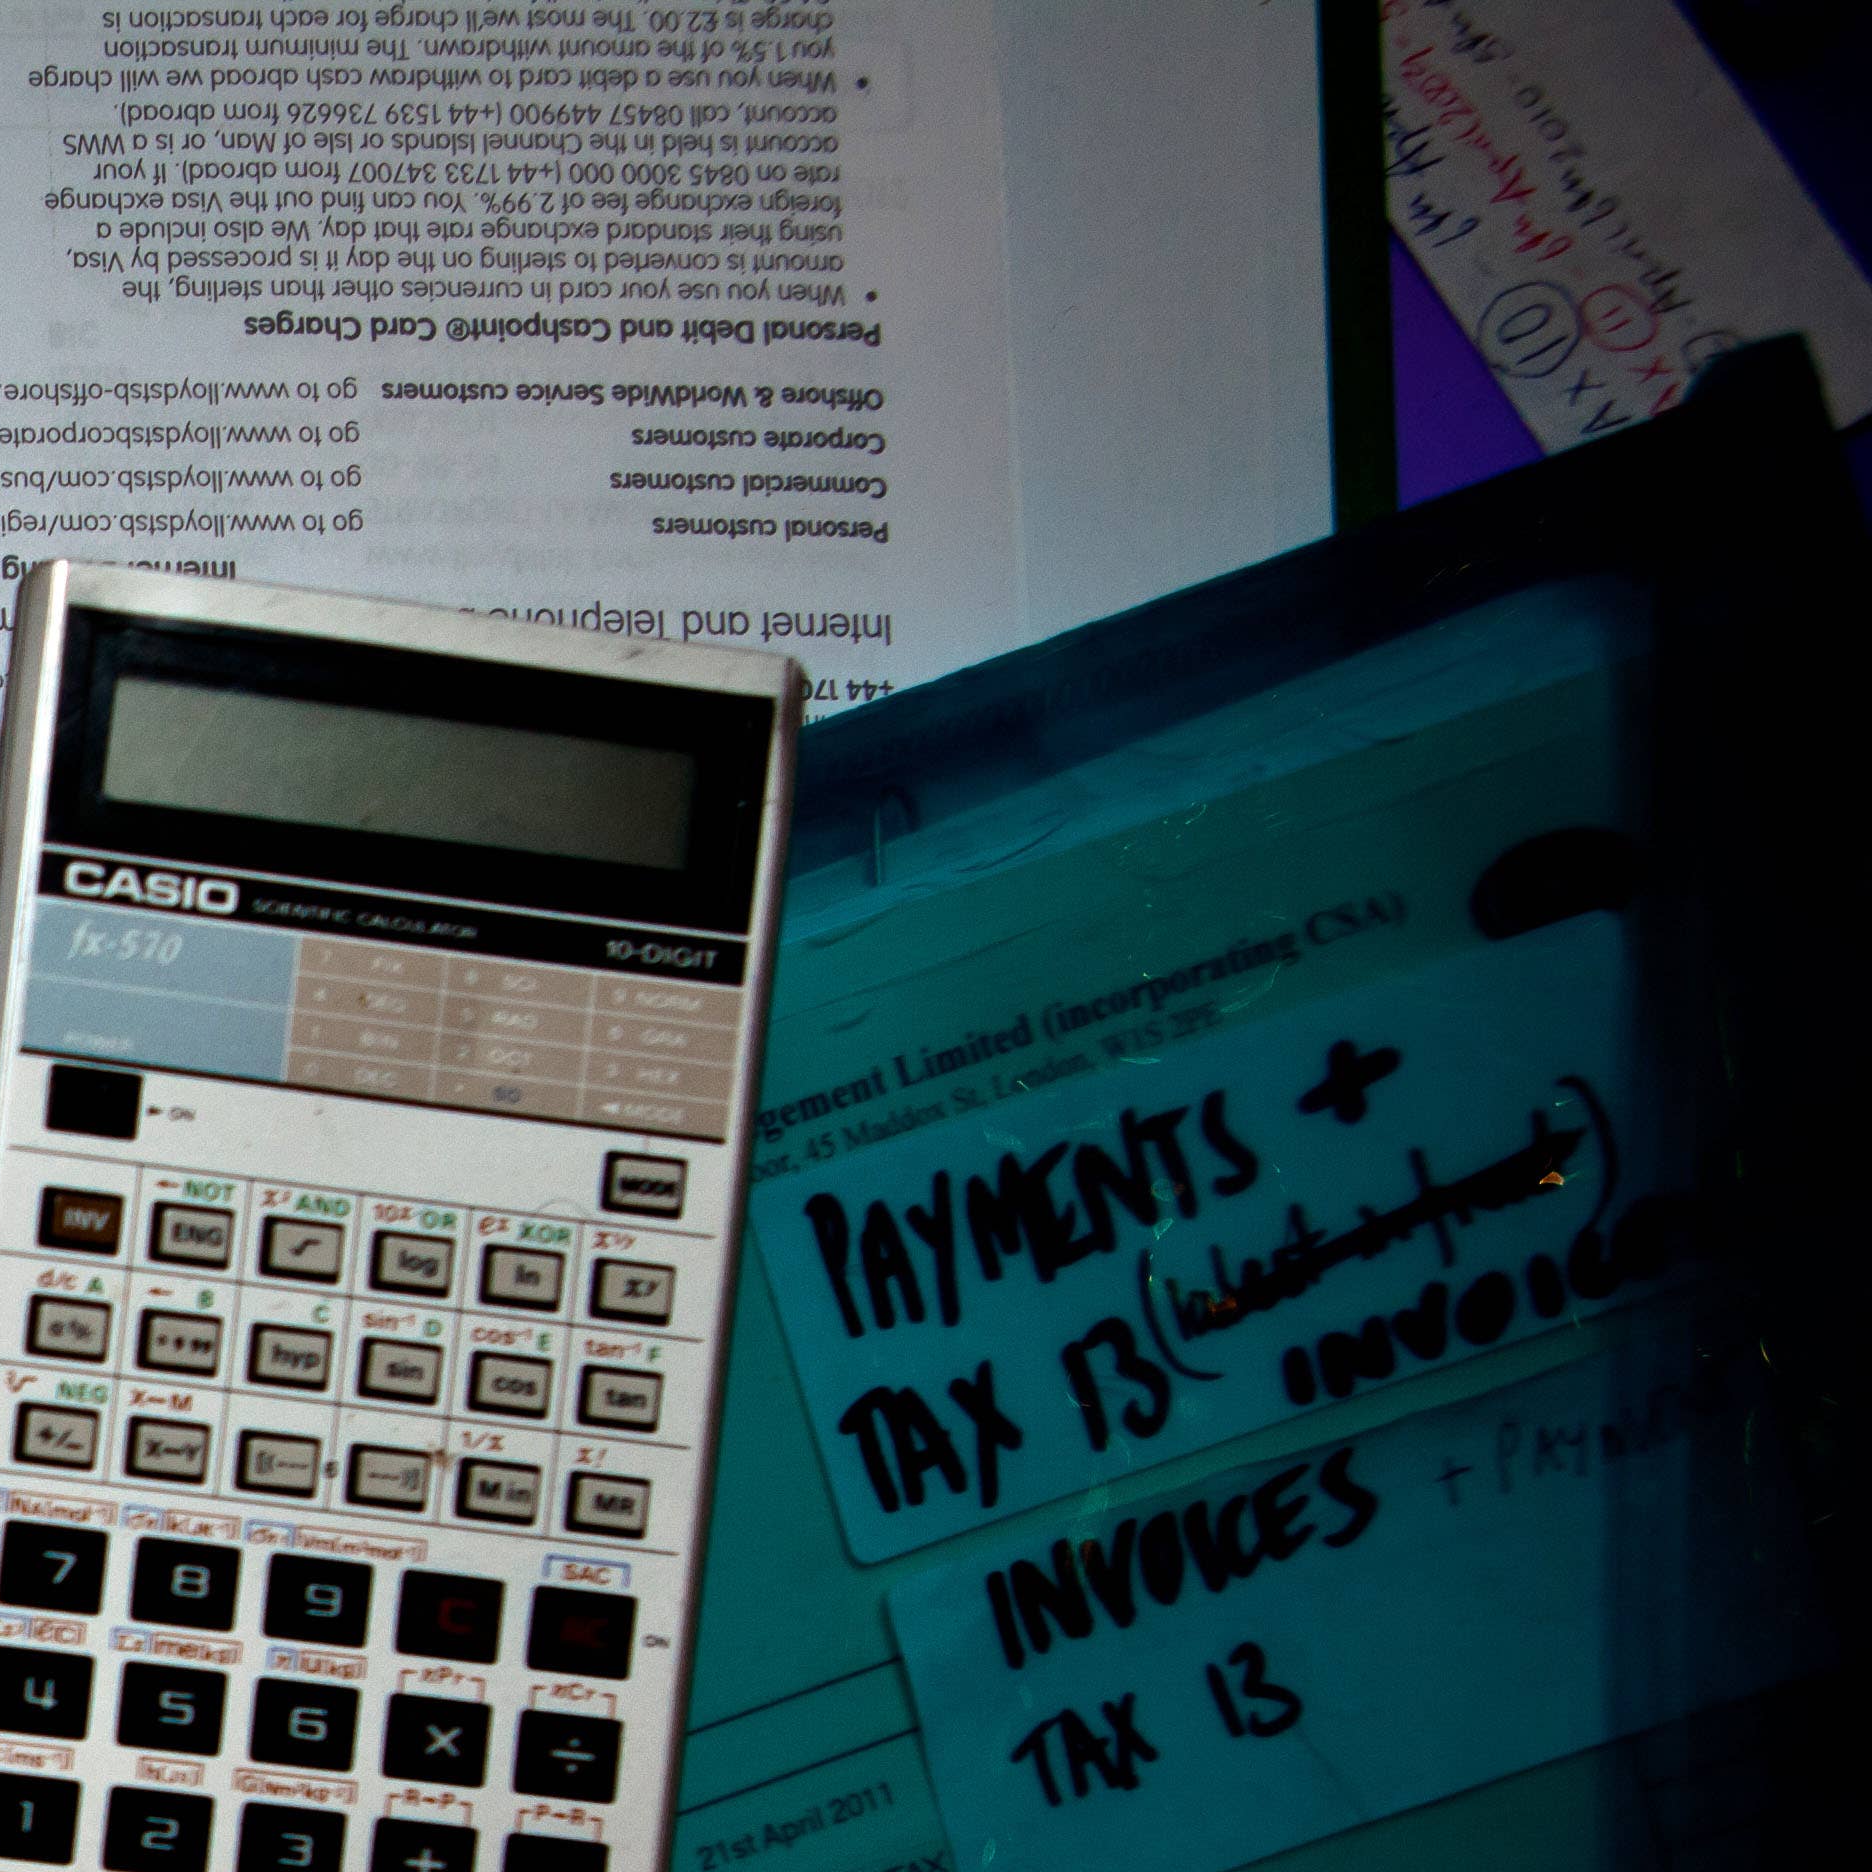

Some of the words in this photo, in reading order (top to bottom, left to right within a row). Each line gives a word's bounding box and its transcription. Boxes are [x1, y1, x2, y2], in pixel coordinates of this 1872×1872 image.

[300, 470, 322, 491] to
[330, 464, 360, 487] go
[652, 516, 776, 538] customers
[784, 520, 888, 544] Personal
[62, 860, 240, 918] CASIO
[604, 938, 720, 973] 10-DIGIT
[803, 1089, 1259, 1337] PAYMENTS
[397, 1249, 439, 1278] log
[385, 1361, 424, 1381] sin
[491, 1375, 537, 1396] cos
[604, 1388, 647, 1408] tan
[837, 1359, 1023, 1513] TAX
[1060, 1316, 1171, 1451] 13
[43, 1550, 76, 1583] 7
[170, 1563, 210, 1598] 8
[304, 1583, 342, 1617] 9
[987, 1443, 1381, 1670] INVOICES
[23, 1677, 56, 1709] 4
[158, 1690, 194, 1725] 5
[288, 1706, 327, 1741] 6
[1010, 1692, 1158, 1807] TAX
[1205, 1641, 1303, 1737] 13
[20, 1800, 34, 1830] 1
[140, 1816, 179, 1850] 2
[278, 1832, 313, 1866] 3
[761, 1805, 826, 1850] April
[825, 1780, 894, 1825] 2011
